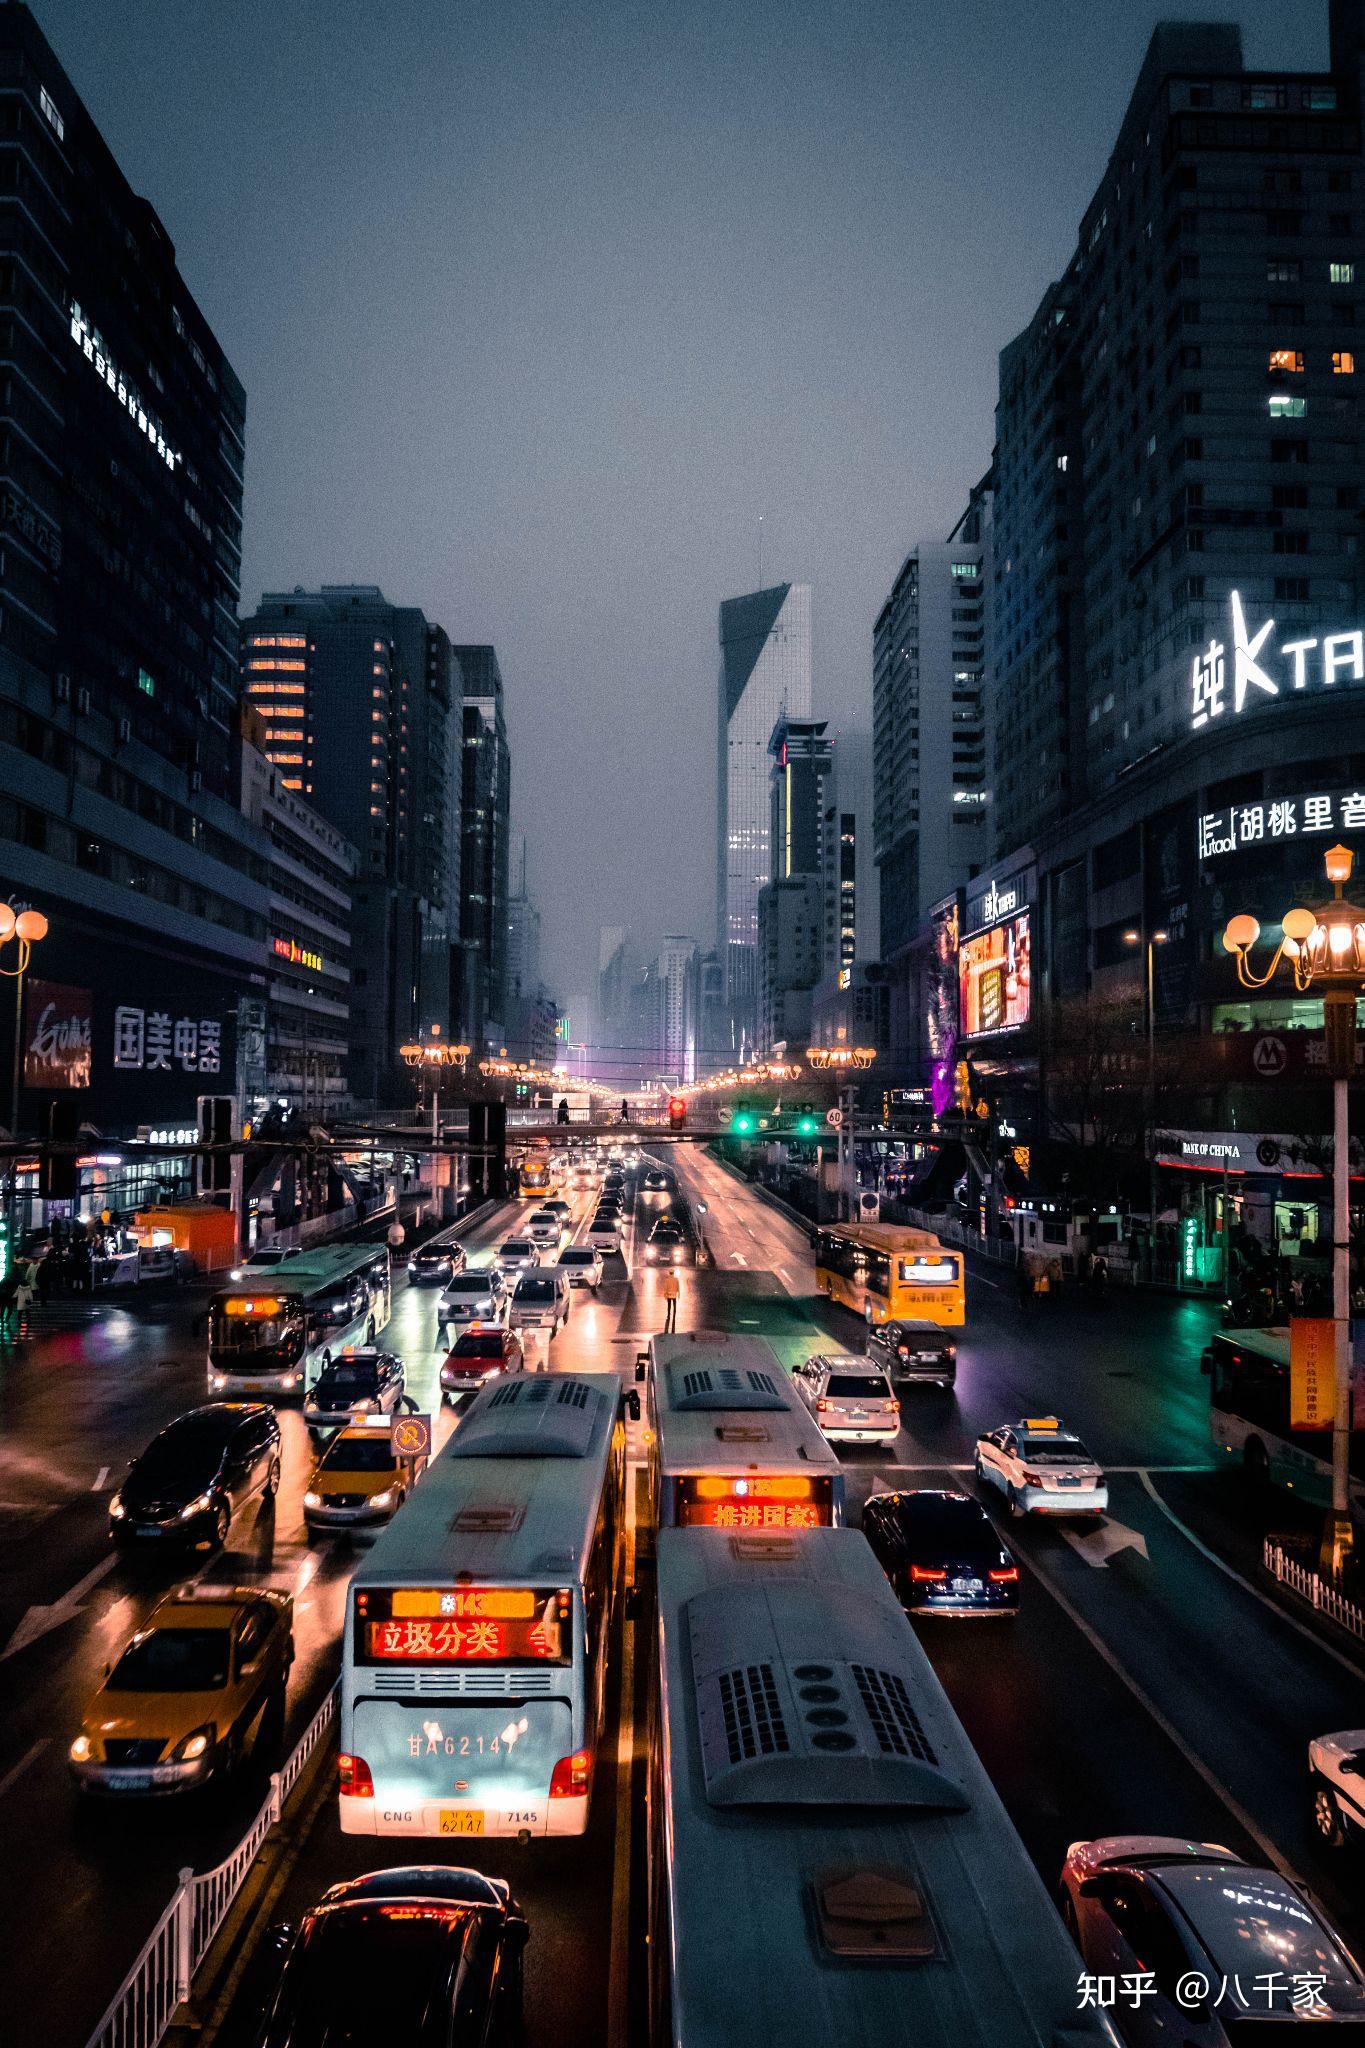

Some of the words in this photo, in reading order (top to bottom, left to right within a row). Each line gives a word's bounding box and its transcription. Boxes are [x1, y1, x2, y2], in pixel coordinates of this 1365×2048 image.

[1240, 792, 1365, 842] 胡桃里音
[114, 1006, 221, 1073] 国美电器
[829, 1111, 840, 1122] 60
[1183, 1142, 1199, 1155] BANK
[1199, 1144, 1209, 1155] OF
[1209, 1144, 1240, 1158] CHINA
[713, 1504, 815, 1527] 推进国家
[457, 1593, 488, 1616] 143
[384, 1811, 413, 1822] CNG
[508, 1812, 538, 1822] 7145
